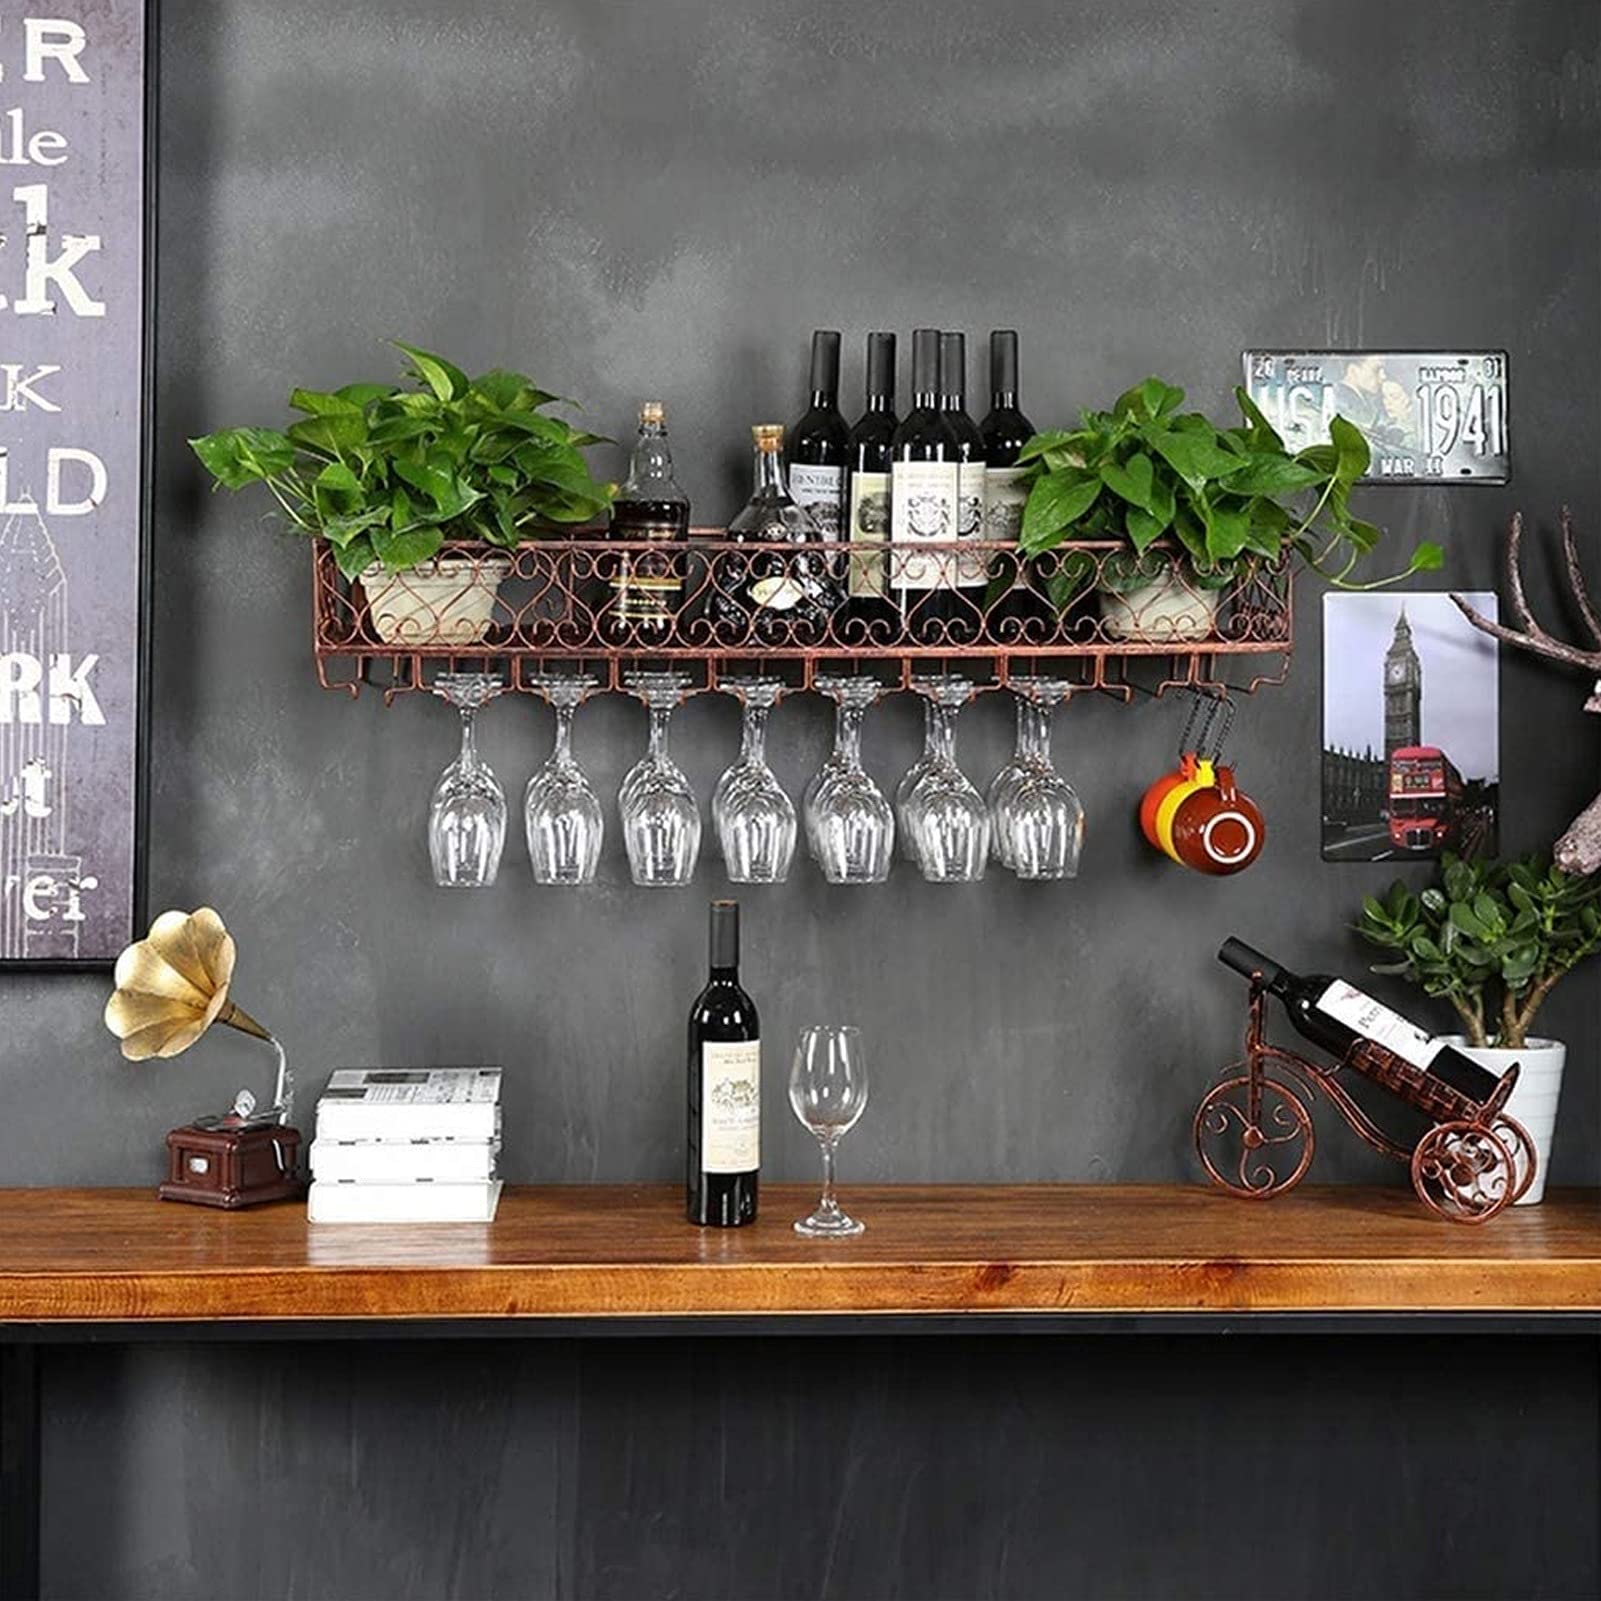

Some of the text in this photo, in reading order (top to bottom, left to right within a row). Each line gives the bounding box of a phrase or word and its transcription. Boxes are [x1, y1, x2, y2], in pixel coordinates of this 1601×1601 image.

[0, 17, 90, 83] R
[0, 107, 69, 165] le
[0, 184, 106, 317] k
[1416, 383, 1502, 456] 1941
[5, 875, 98, 920] er
